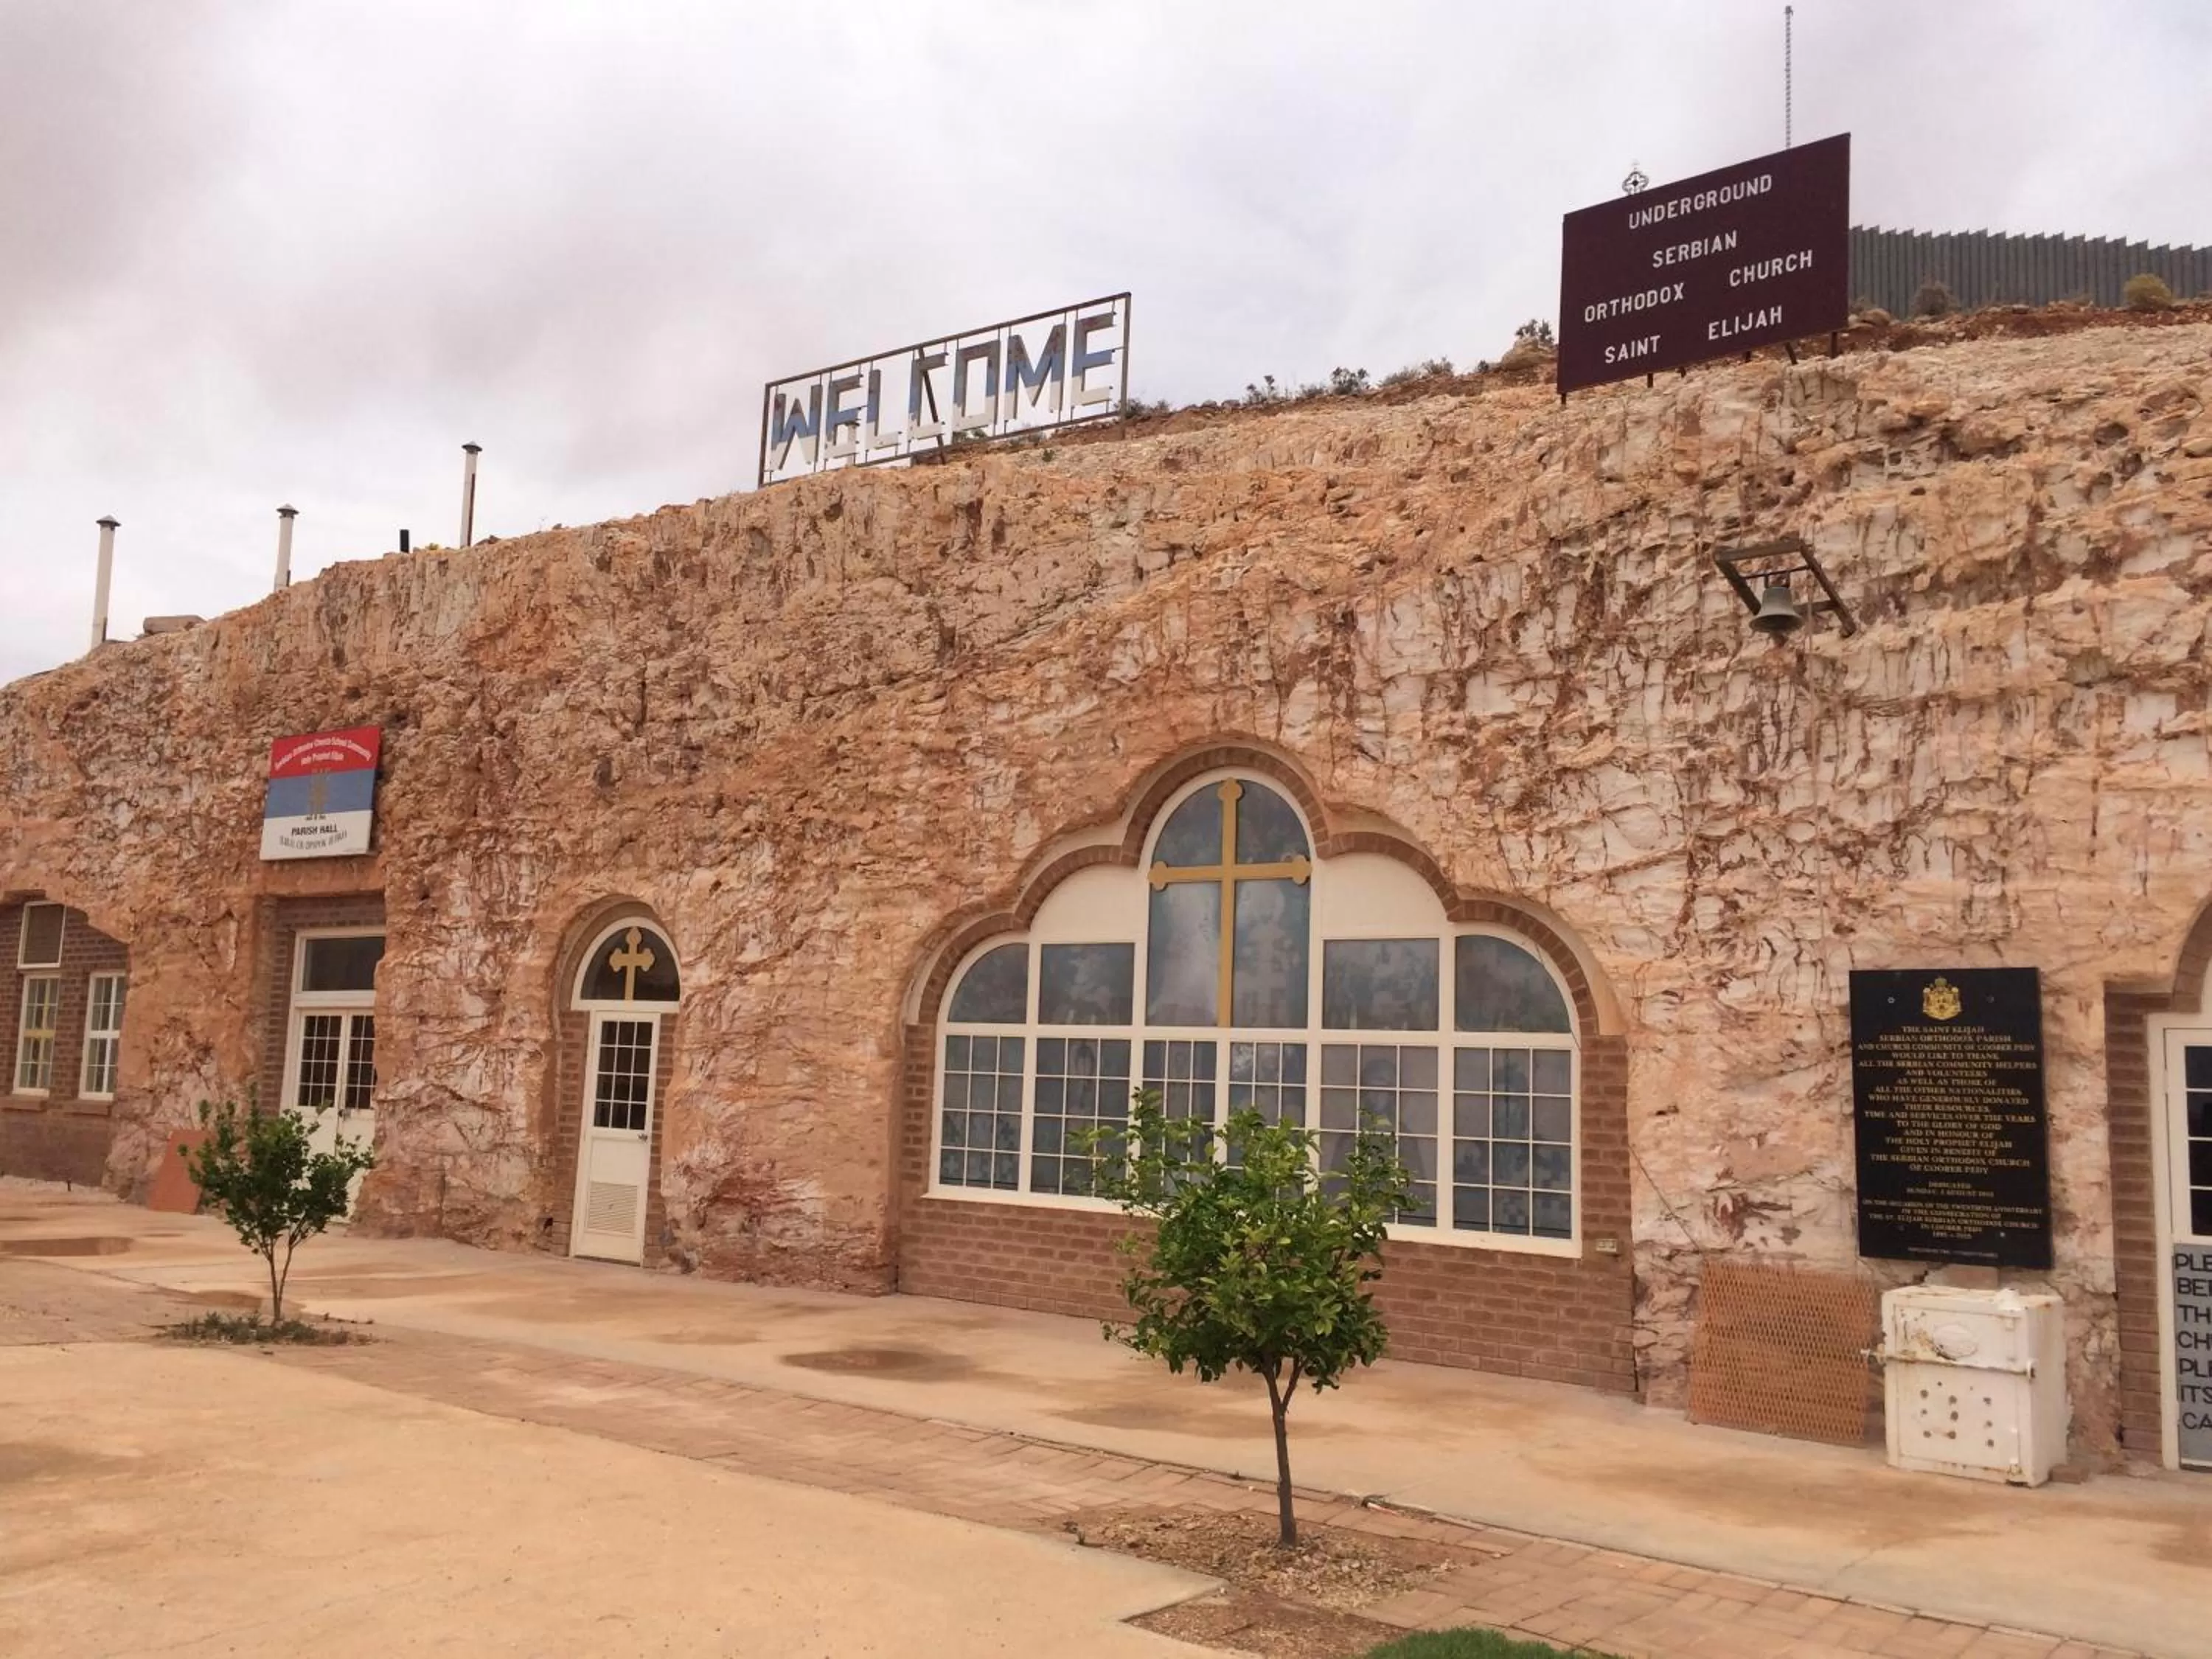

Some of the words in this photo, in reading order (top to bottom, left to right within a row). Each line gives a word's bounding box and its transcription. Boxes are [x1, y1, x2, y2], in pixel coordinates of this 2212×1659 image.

[1628, 174, 1773, 229] UNDERGROUND
[1652, 230, 1738, 268] SERBIAN
[1585, 282, 1685, 323] ORTHODOX
[1729, 249, 1813, 288] CHURCH
[1604, 335, 1660, 364] SAINT
[1708, 305, 1782, 341] ELIJAH
[768, 311, 1116, 470] WELCOME
[291, 826, 318, 836] PARISH
[319, 823, 337, 833] HALL
